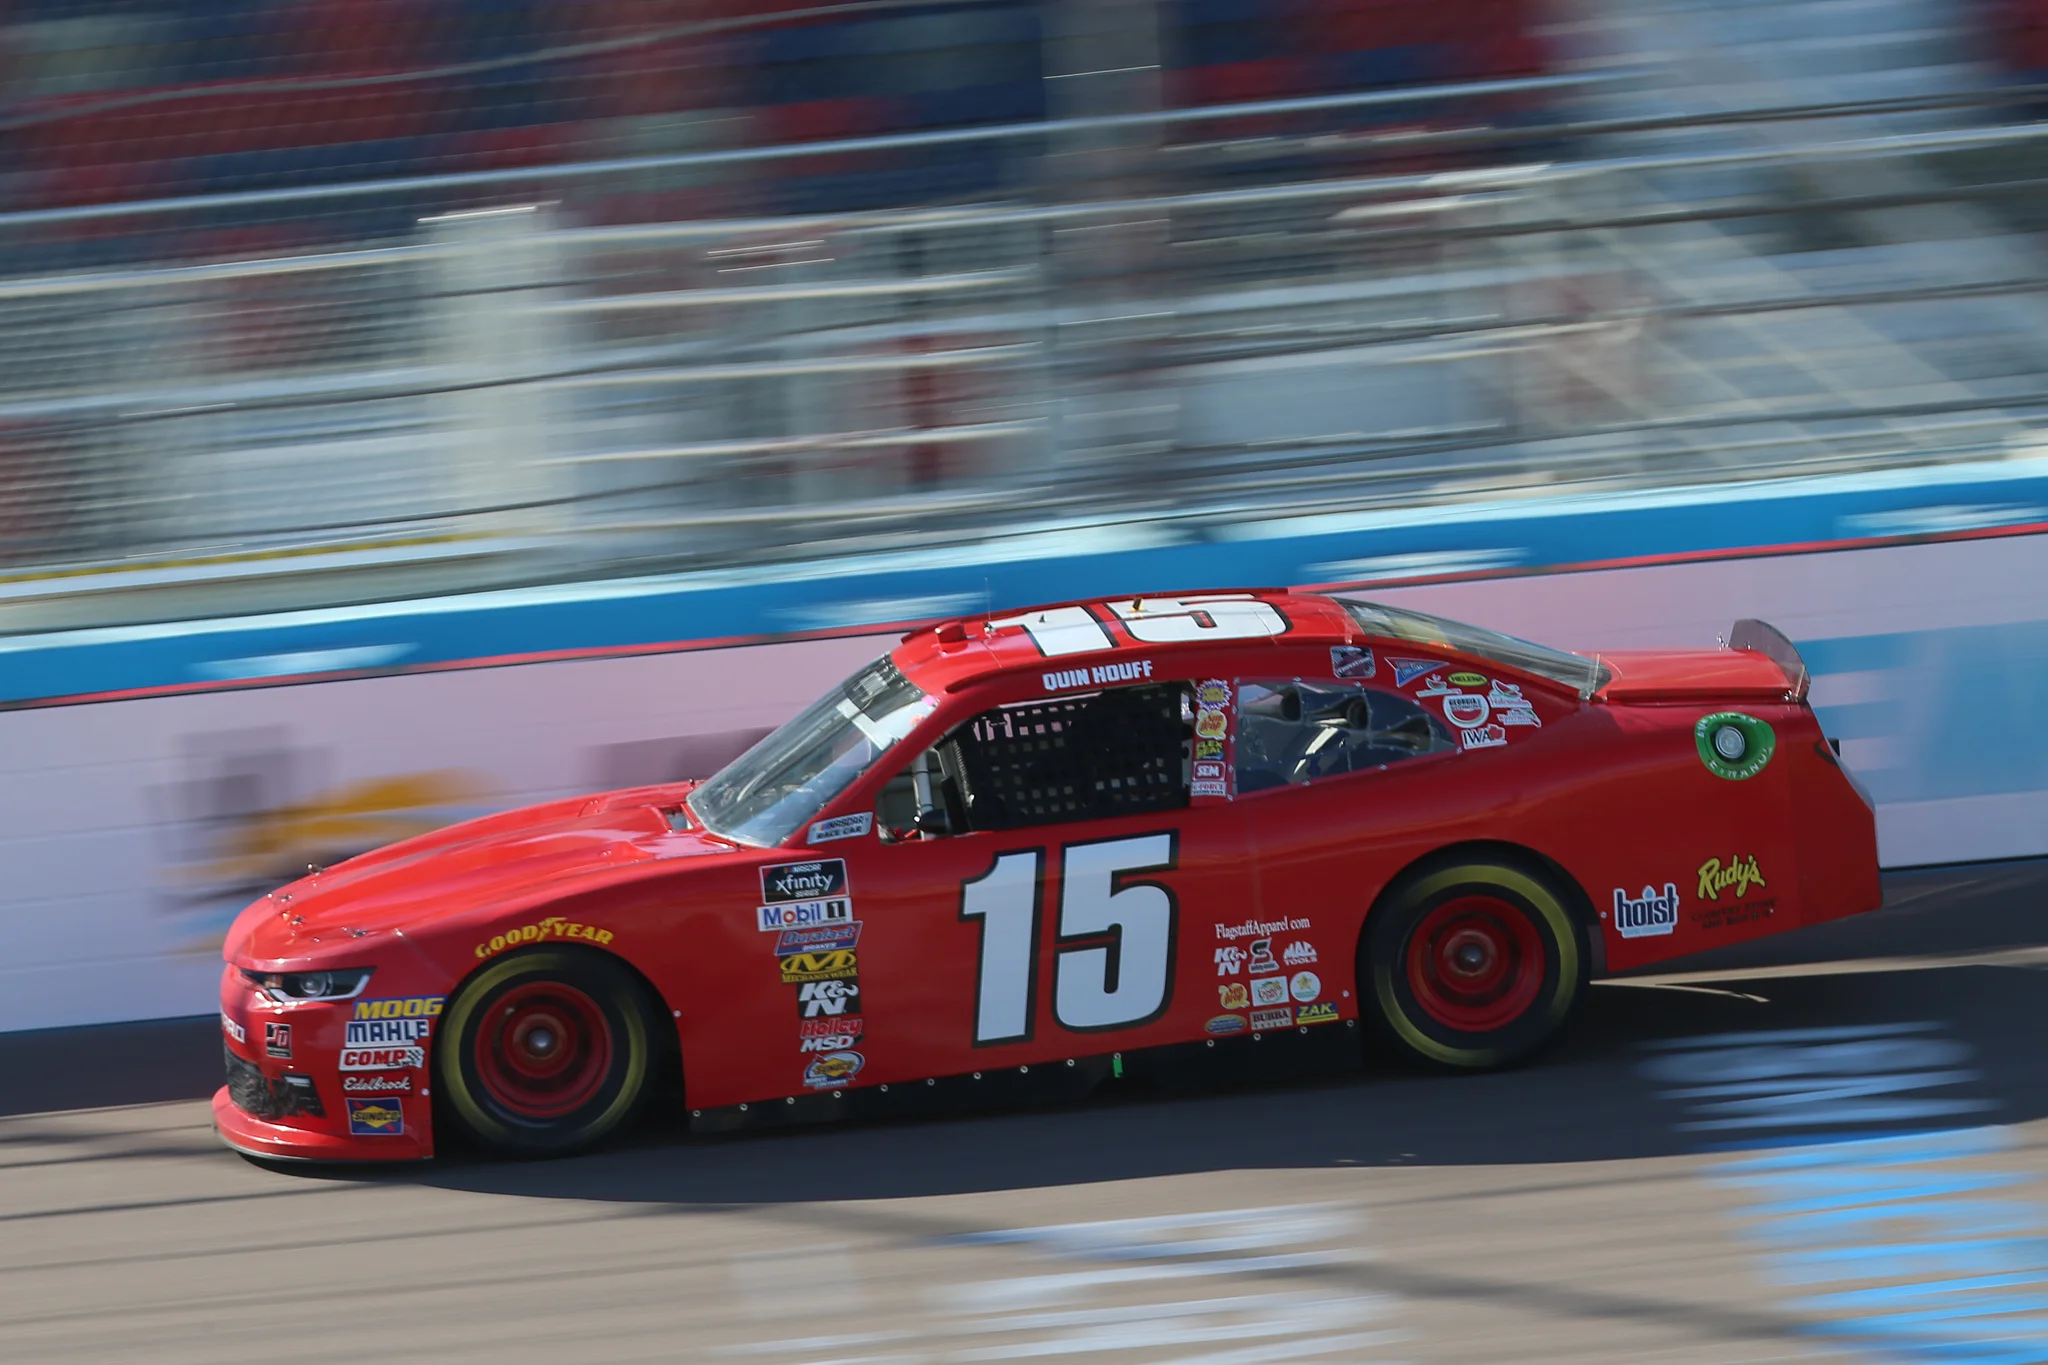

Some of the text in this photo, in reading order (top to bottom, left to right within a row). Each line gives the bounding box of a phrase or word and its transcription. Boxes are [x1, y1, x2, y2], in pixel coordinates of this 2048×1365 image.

[988, 593, 1292, 658] 15
[1042, 660, 1153, 691] QUIN HOUFF
[1464, 729, 1492, 745] IWA
[1197, 765, 1219, 777] SEM
[816, 826, 862, 840] RACE CAR
[776, 873, 834, 895] xfinity
[1697, 854, 1766, 900] Rudy's
[763, 902, 821, 928] Mobil
[1615, 884, 1679, 929] hoist
[961, 831, 1174, 1045] 15
[354, 997, 443, 1020] MOOG
[1298, 1003, 1333, 1017] ZAK
[347, 1020, 428, 1043] MAHLE
[800, 1018, 863, 1038] Holley
[800, 1035, 855, 1053] MSD
[344, 1049, 407, 1067] COMP
[343, 1075, 412, 1091] Edelbrock
[353, 1111, 401, 1121] SUNOCO
